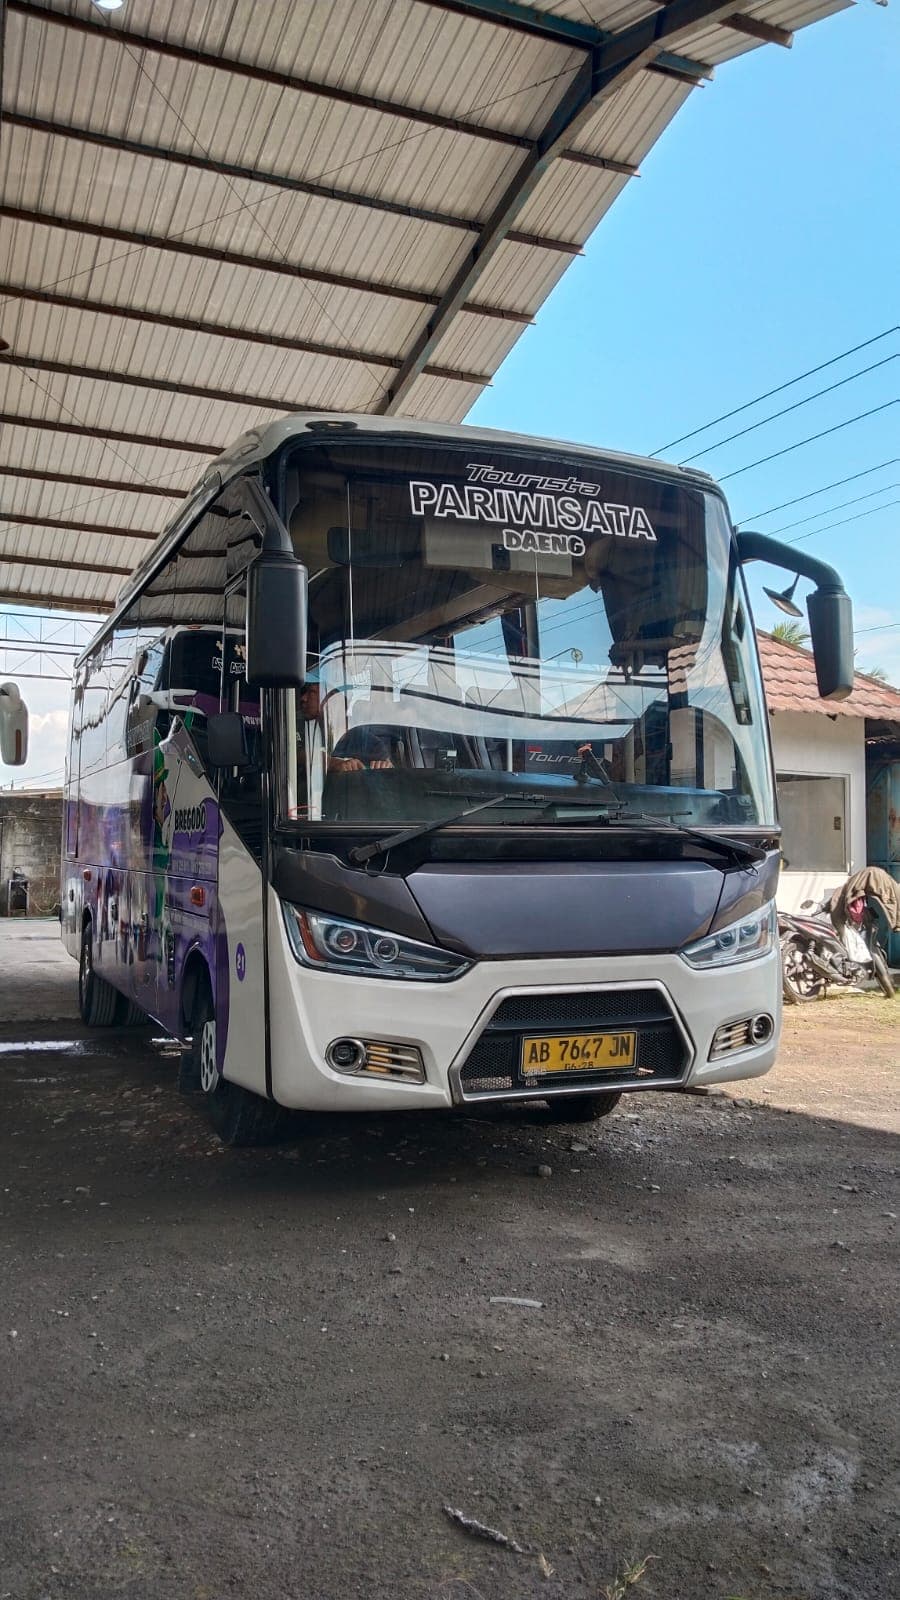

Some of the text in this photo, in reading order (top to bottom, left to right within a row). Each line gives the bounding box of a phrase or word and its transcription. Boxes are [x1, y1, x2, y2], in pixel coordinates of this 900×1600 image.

[466, 463, 601, 496] Tourista
[409, 481, 657, 541] PARIWISATA
[502, 529, 586, 557] DAENG
[174, 805, 206, 833] BREGODO
[236, 953, 245, 970] 21
[528, 1042, 550, 1063] AB
[609, 1035, 631, 1057] JN
